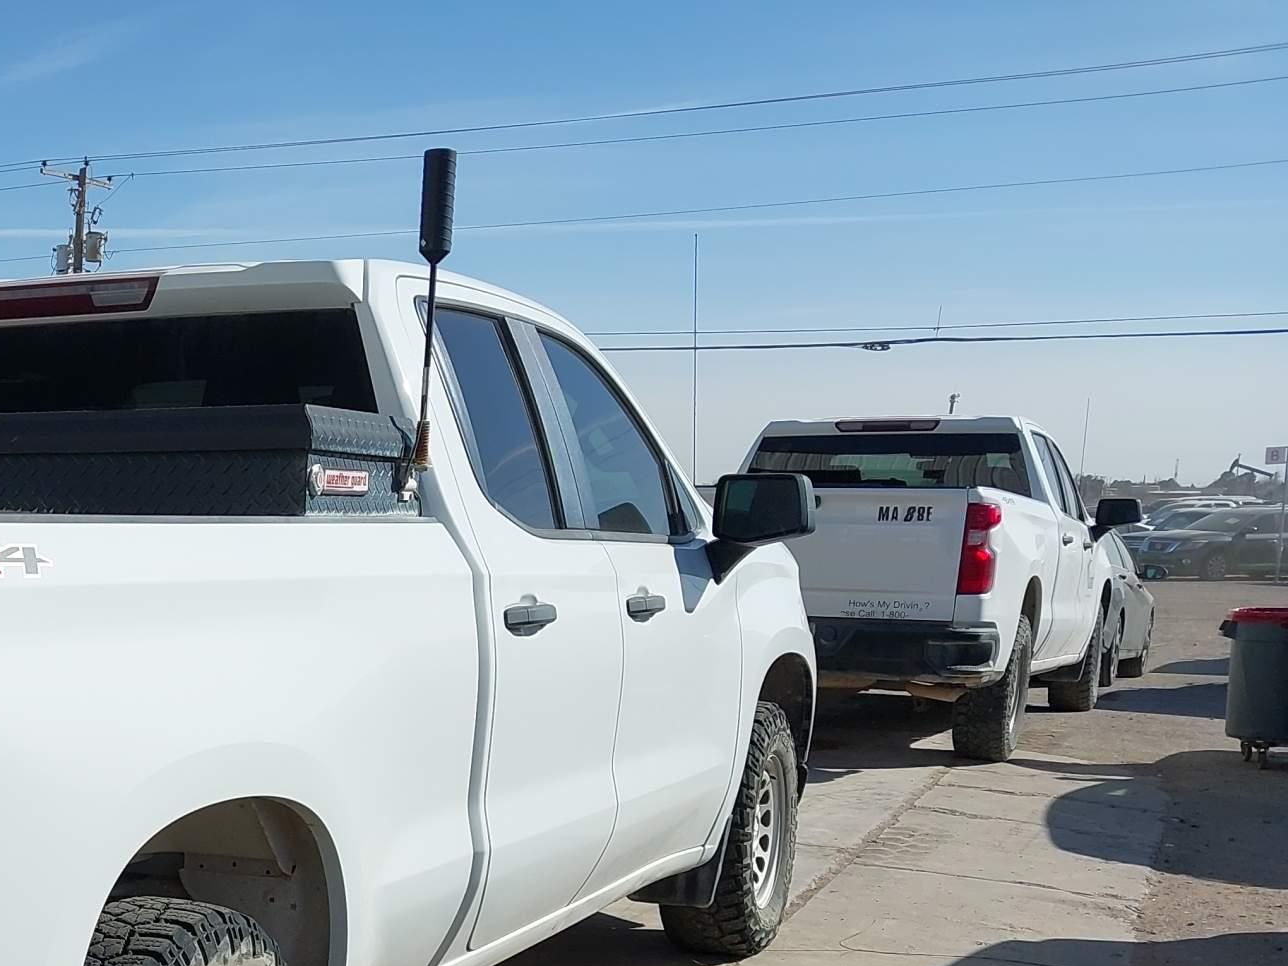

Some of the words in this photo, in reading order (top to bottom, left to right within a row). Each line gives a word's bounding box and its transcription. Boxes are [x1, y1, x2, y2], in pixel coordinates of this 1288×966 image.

[326, 473, 350, 485] weather
[351, 474, 367, 486] guard
[877, 506, 899, 522] MA
[848, 600, 875, 608] How's
[877, 600, 891, 609] My
[893, 601, 931, 611] Drivin?
